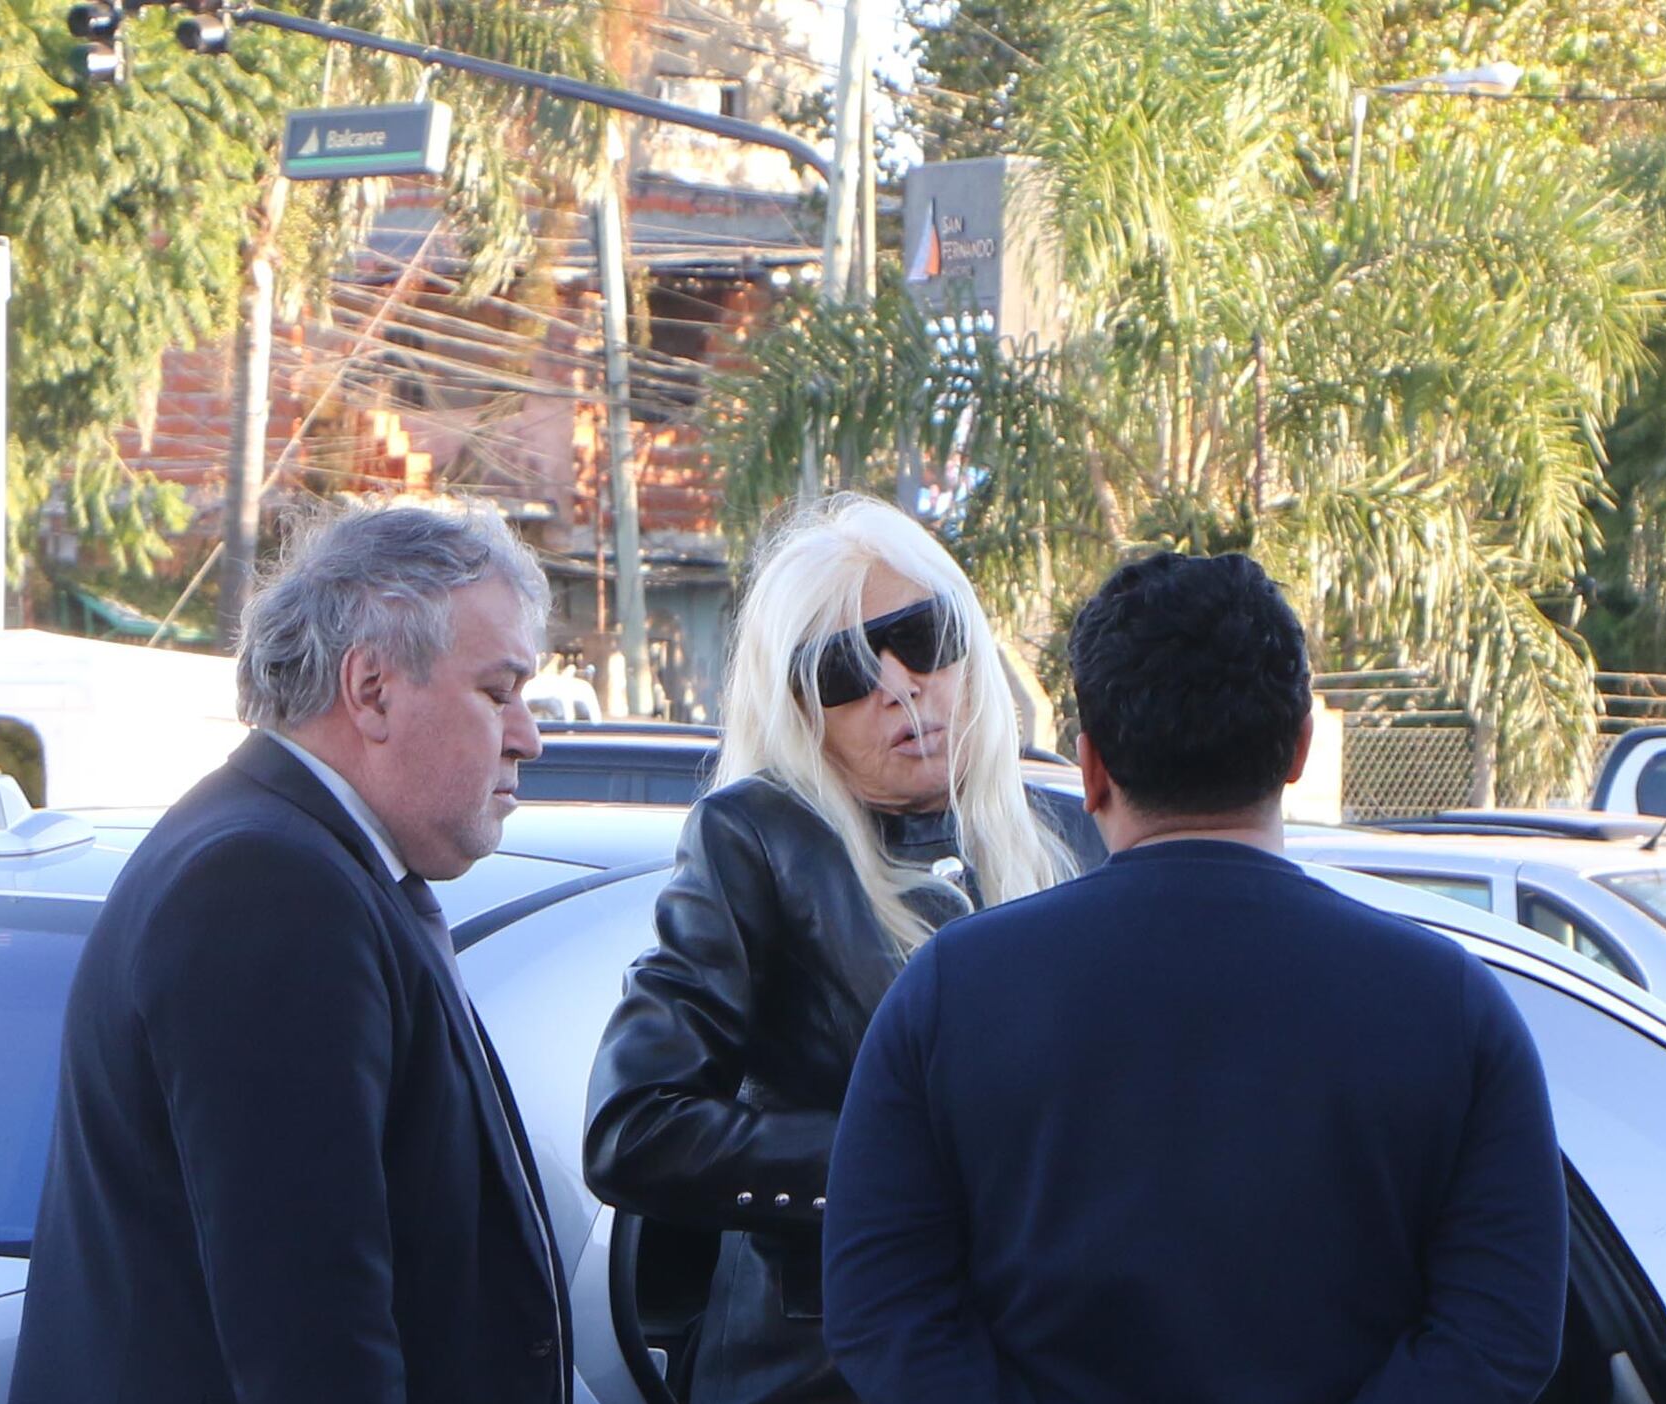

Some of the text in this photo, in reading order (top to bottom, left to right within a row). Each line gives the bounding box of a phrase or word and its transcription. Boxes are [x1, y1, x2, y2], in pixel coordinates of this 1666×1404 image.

[325, 128, 387, 149] Balcarce
[941, 215, 965, 234] SAN
[941, 238, 996, 260] FERNANDO
